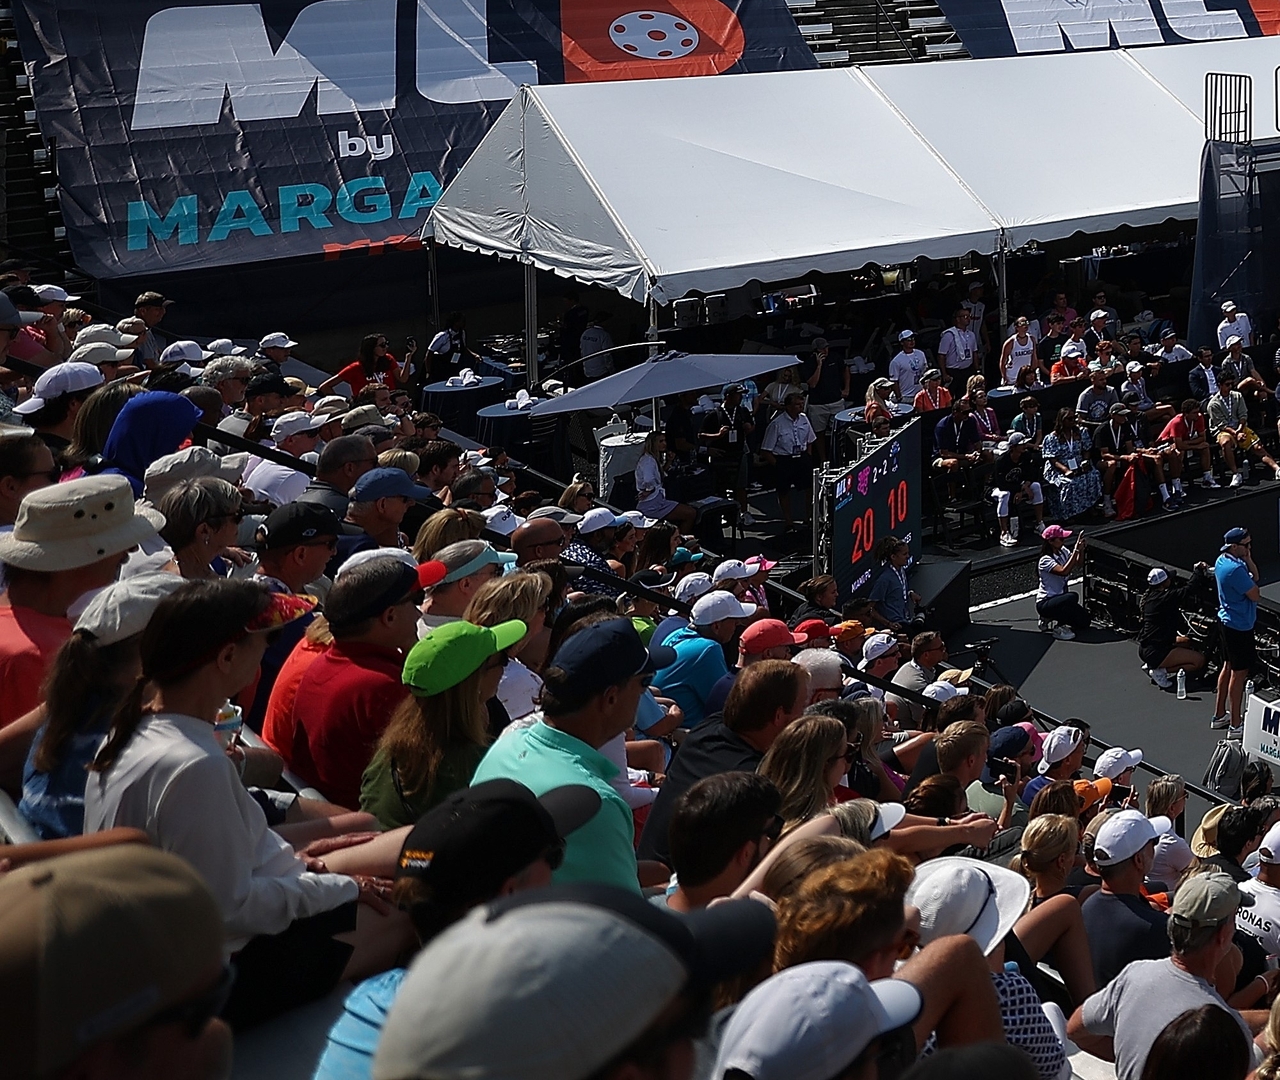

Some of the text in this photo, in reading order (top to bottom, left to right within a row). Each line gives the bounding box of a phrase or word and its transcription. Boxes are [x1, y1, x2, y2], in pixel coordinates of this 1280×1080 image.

[337, 130, 393, 161] by
[126, 169, 446, 251] MARGA
[851, 480, 907, 565] 20 10
